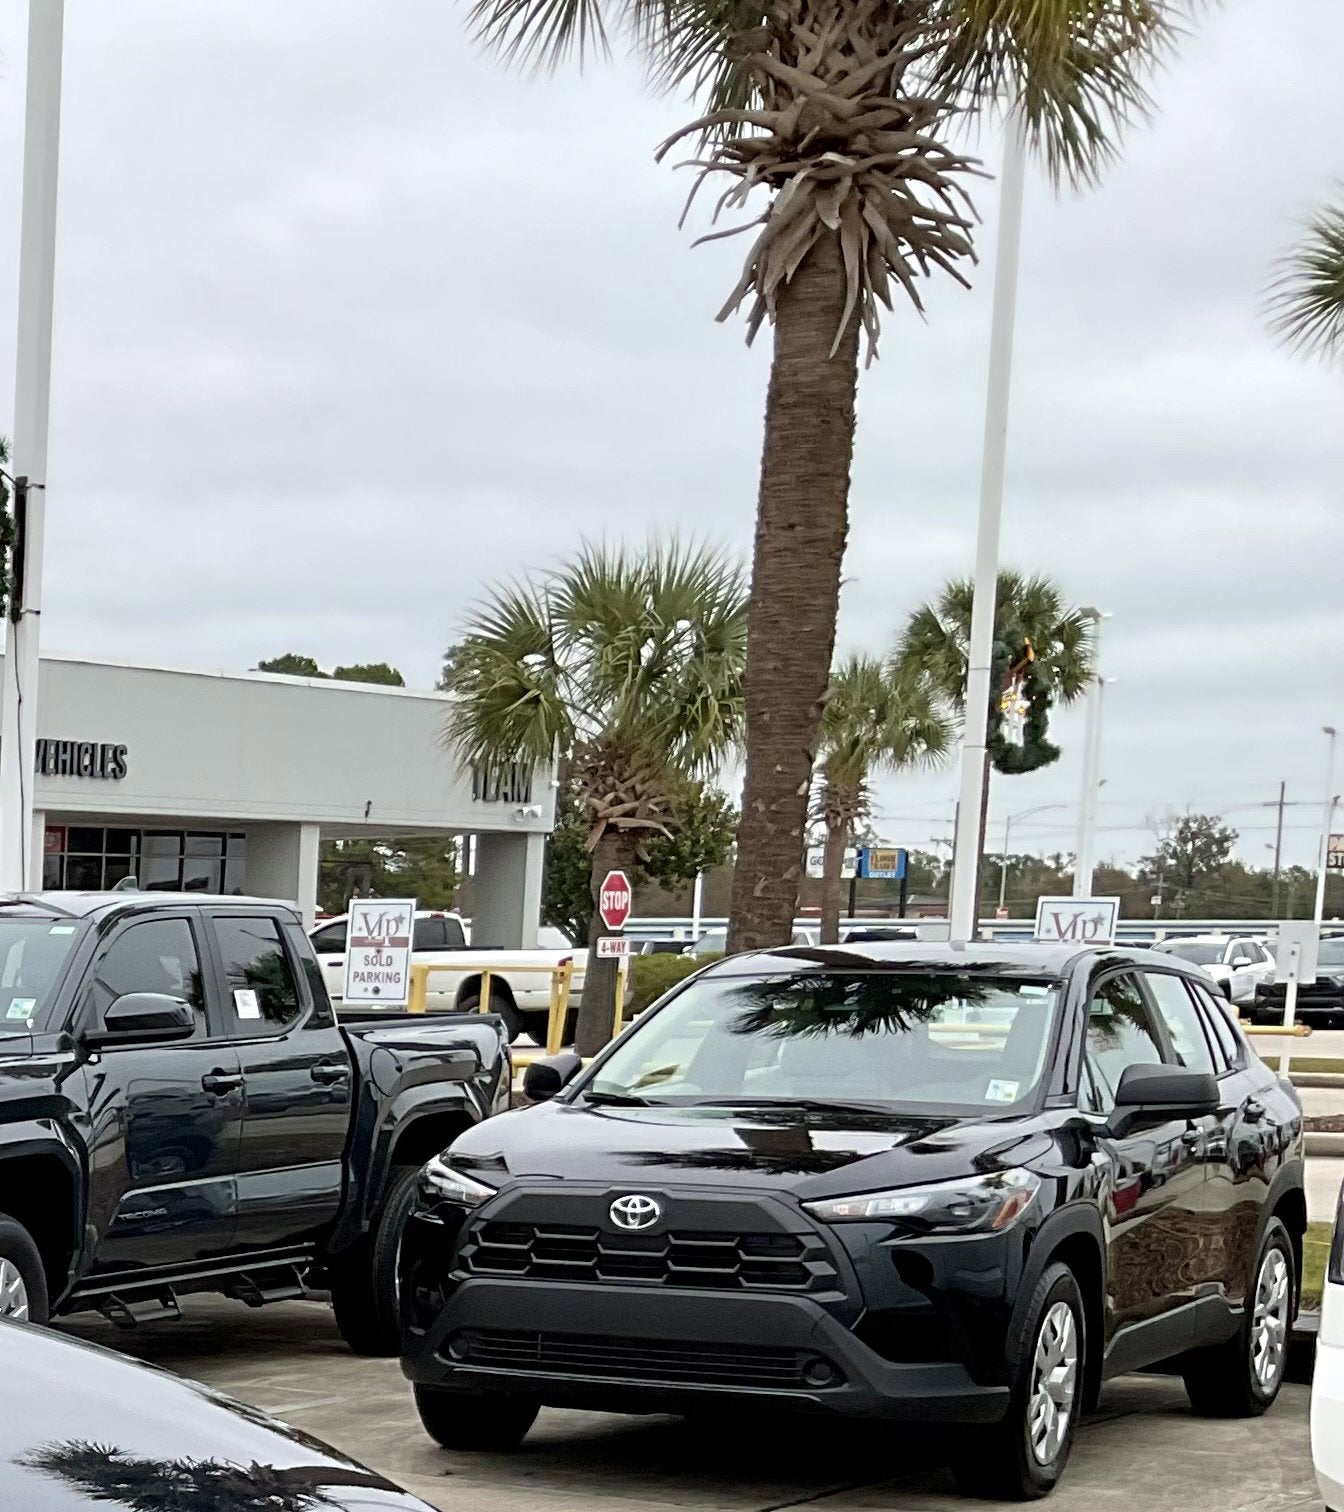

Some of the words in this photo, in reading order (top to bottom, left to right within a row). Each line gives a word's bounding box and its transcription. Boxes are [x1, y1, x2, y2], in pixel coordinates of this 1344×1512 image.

[602, 891, 628, 910] STOP
[601, 941, 625, 953] 4-WAY
[363, 955, 393, 966] SOLD
[352, 971, 401, 983] PARKING
